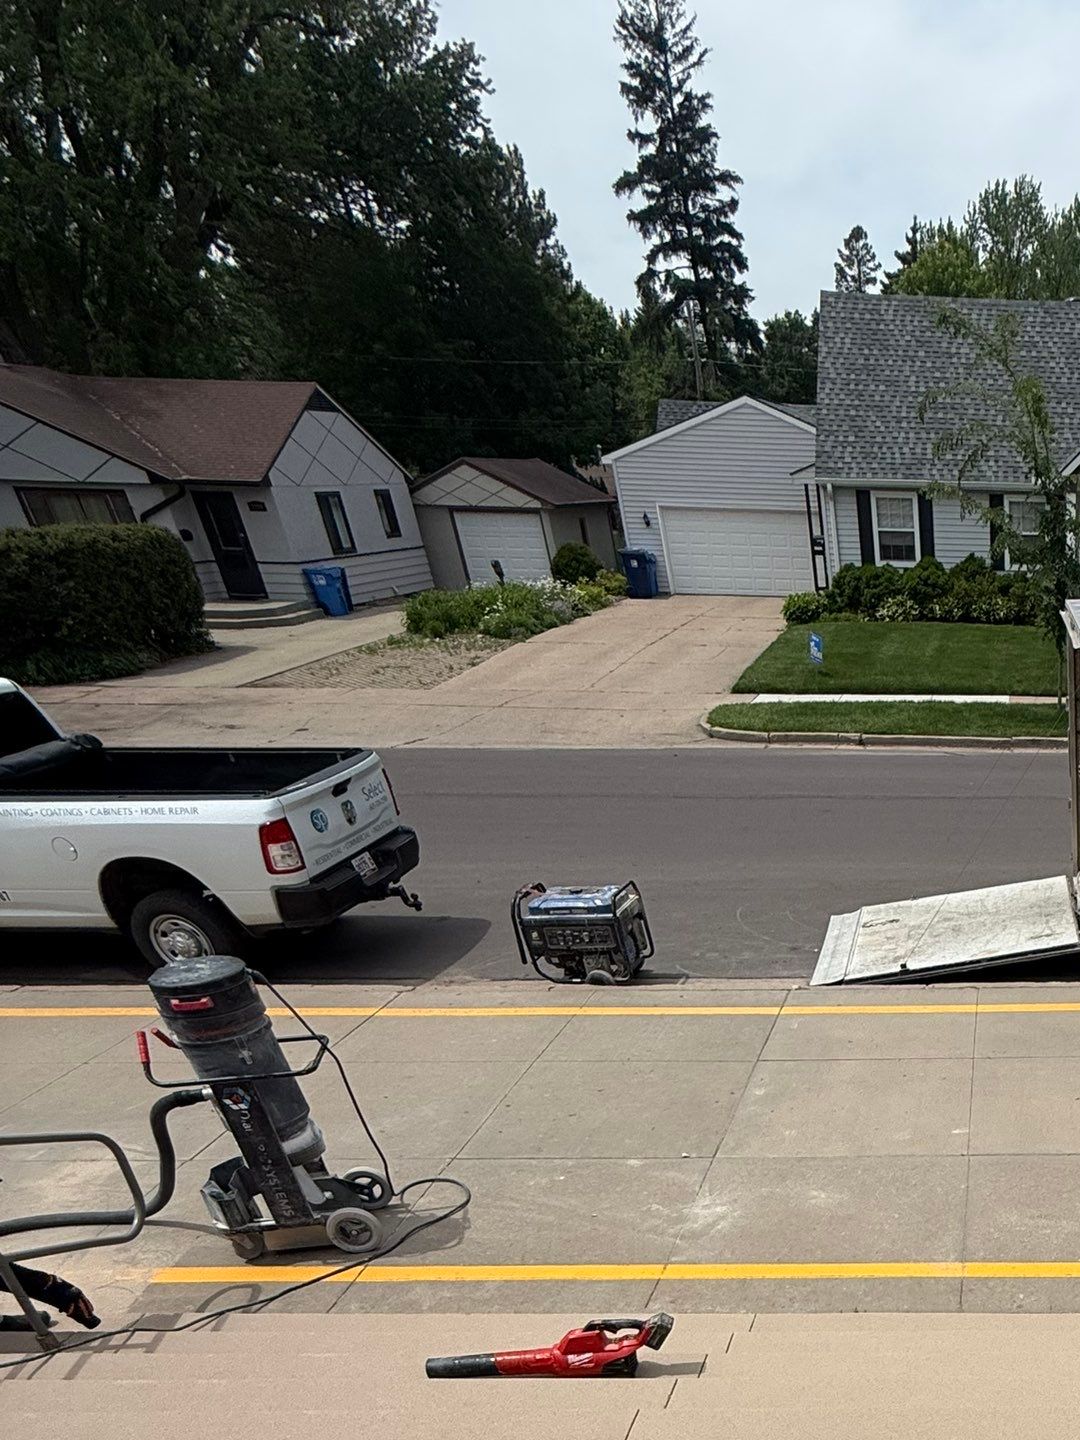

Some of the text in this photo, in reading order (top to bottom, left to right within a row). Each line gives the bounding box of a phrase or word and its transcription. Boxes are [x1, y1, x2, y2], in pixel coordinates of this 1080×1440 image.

[362, 781, 386, 801] Select
[40, 807, 83, 817] COATINGS
[90, 807, 133, 816] CABINETS
[141, 807, 166, 816] HOME
[169, 806, 200, 815] REPAIR
